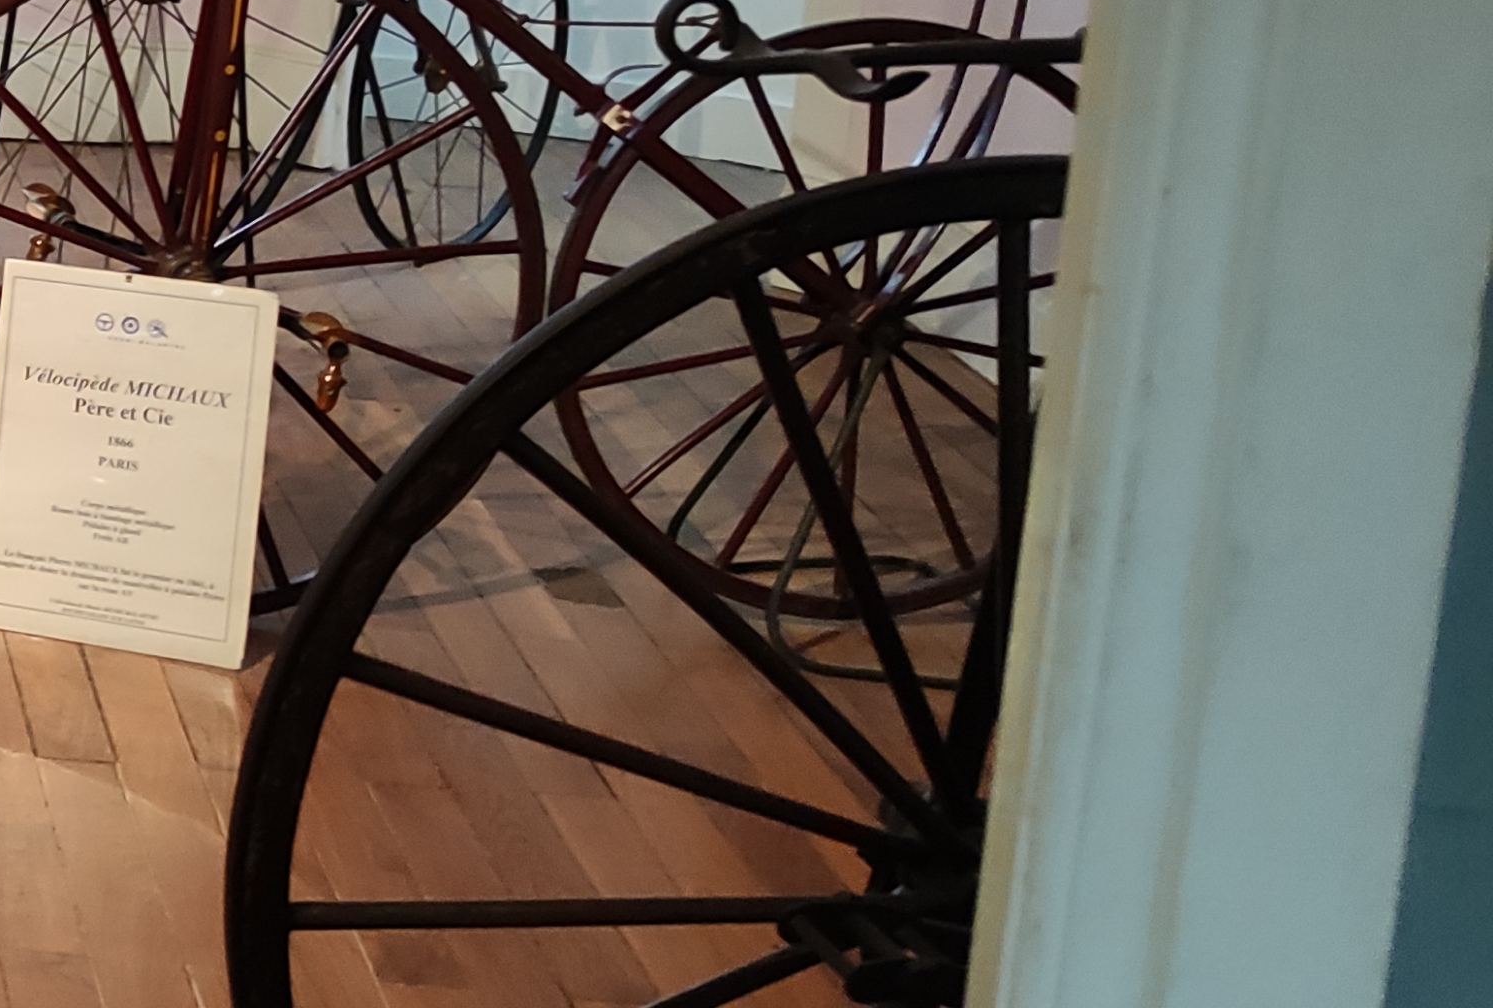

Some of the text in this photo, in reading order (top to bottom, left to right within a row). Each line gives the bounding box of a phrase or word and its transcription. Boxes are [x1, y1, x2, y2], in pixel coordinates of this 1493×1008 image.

[24, 366, 232, 409] Vélocipède MICHAUX
[73, 396, 174, 427] Père et Cie
[97, 456, 139, 471] PARIS
